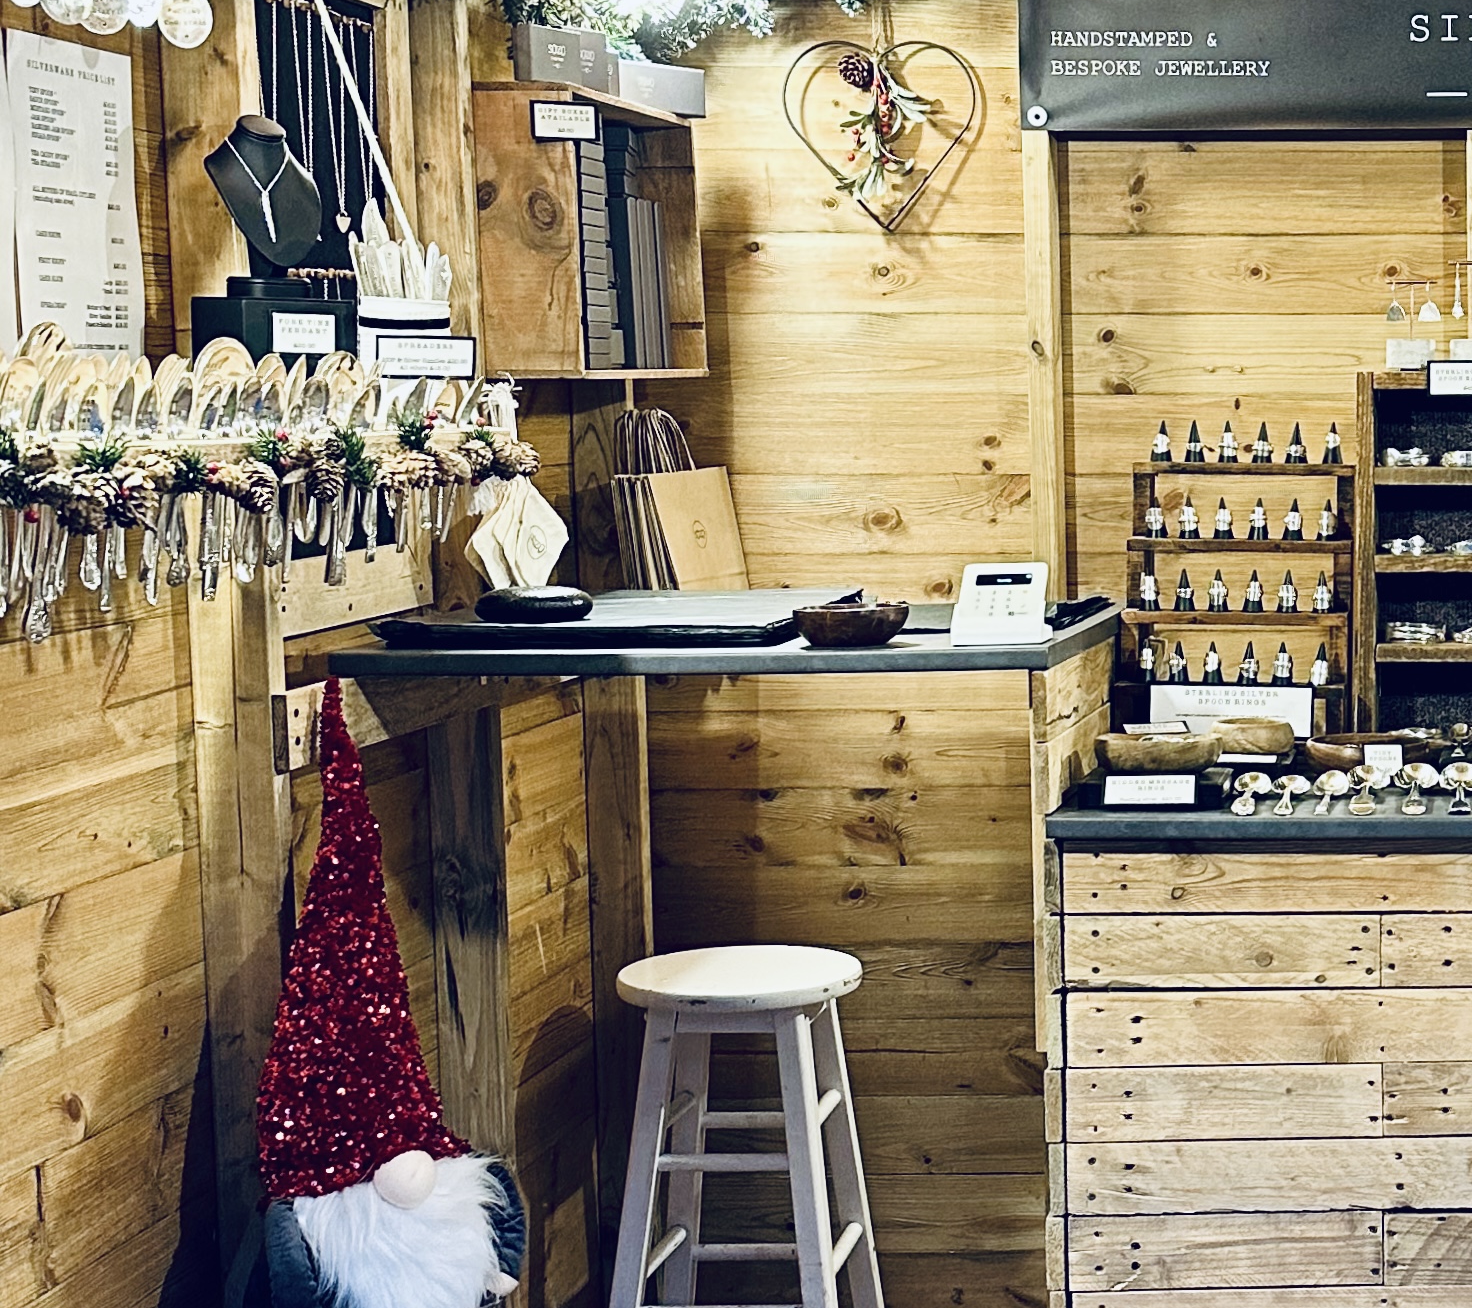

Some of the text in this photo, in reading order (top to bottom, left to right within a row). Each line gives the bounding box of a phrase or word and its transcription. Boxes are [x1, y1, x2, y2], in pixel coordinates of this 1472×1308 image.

[1050, 31, 1218, 48] HANDSTAMPED &
[1050, 59, 1271, 78] BESPOKE JEWELLERY
